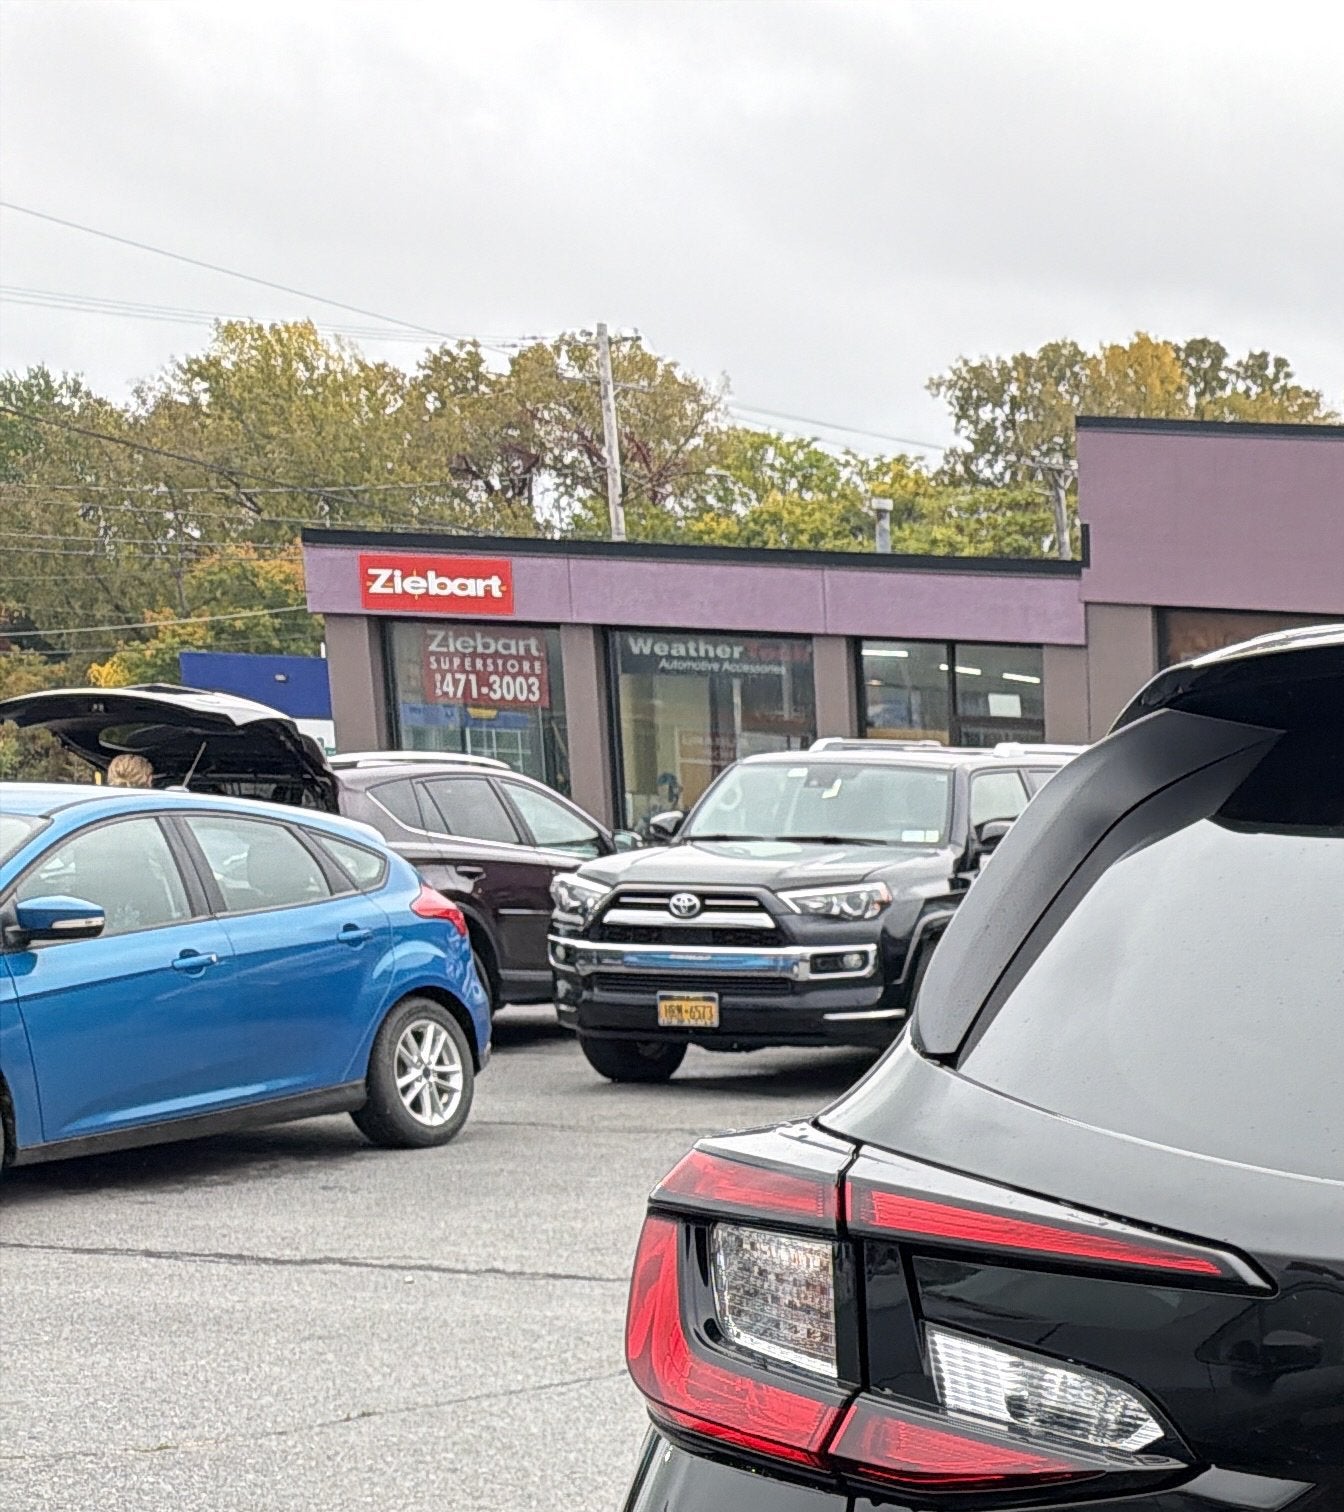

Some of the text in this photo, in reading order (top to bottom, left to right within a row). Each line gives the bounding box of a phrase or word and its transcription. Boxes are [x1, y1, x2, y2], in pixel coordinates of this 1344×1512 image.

[367, 567, 503, 598] Ziebart
[427, 629, 541, 656] Ziebart
[429, 655, 542, 675] SUPERSTORE
